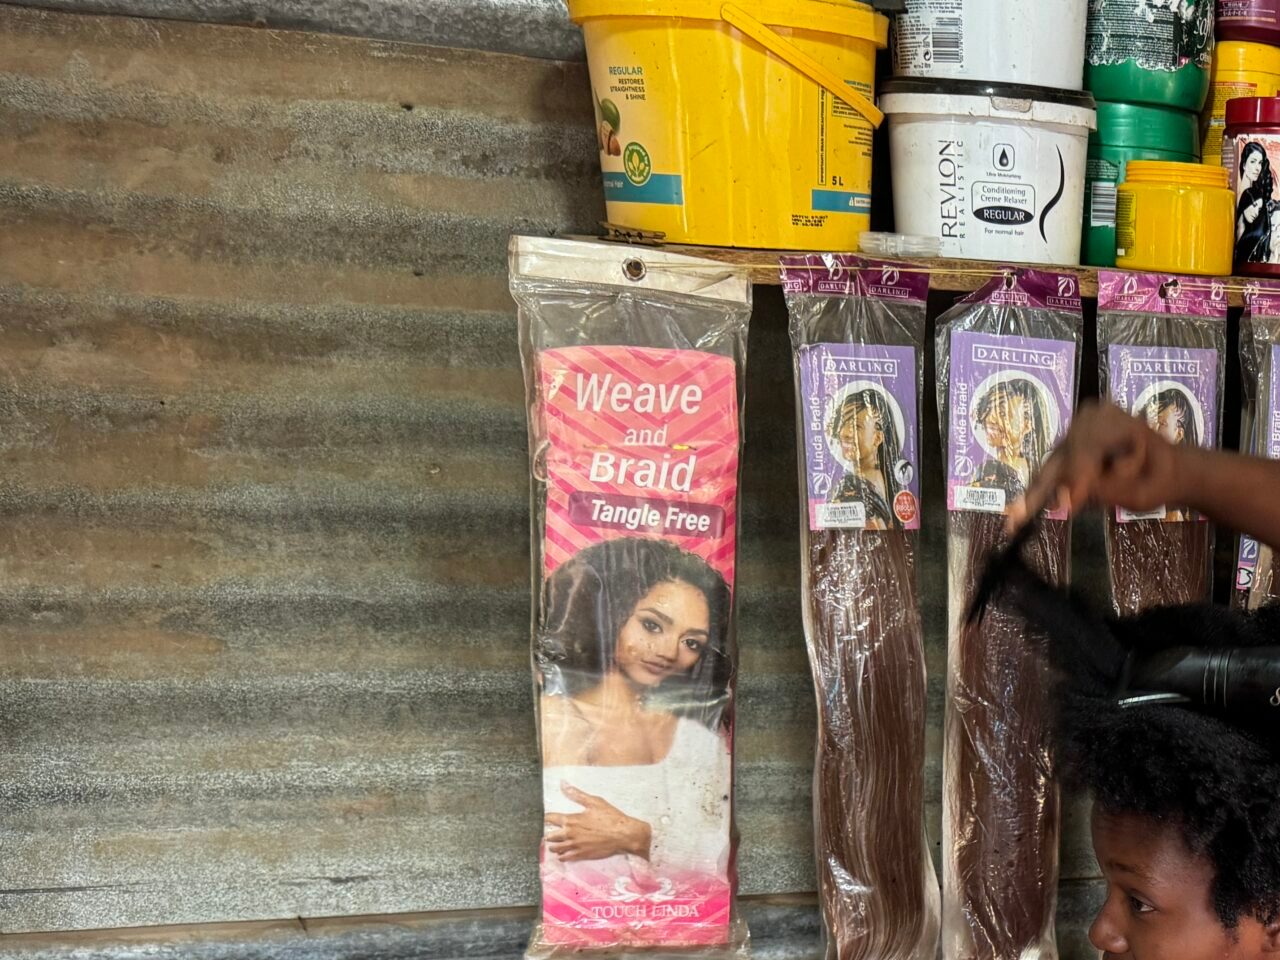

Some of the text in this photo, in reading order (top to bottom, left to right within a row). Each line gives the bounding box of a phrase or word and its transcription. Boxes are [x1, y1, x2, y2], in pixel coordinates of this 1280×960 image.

[609, 66, 643, 75] REGULAR
[832, 176, 843, 186] 5 L
[938, 140, 958, 238] REVLON
[957, 140, 966, 239] REALISTIC
[982, 185, 1026, 196] Conditioning
[981, 195, 1028, 205] Creme Relaxer
[983, 209, 1025, 221] REGULAR
[871, 286, 907, 296] DARLING
[977, 348, 1051, 365] DARLING
[827, 360, 894, 373] DARLING
[1133, 362, 1196, 373] DARLING
[574, 373, 703, 415] Weave
[956, 382, 968, 454] Linda Braid
[624, 425, 668, 446] and
[810, 397, 824, 470] Linda Braid
[589, 451, 697, 492] Braid
[591, 499, 711, 532] Tangle Free
[592, 904, 700, 918] TOUCH LINDA
